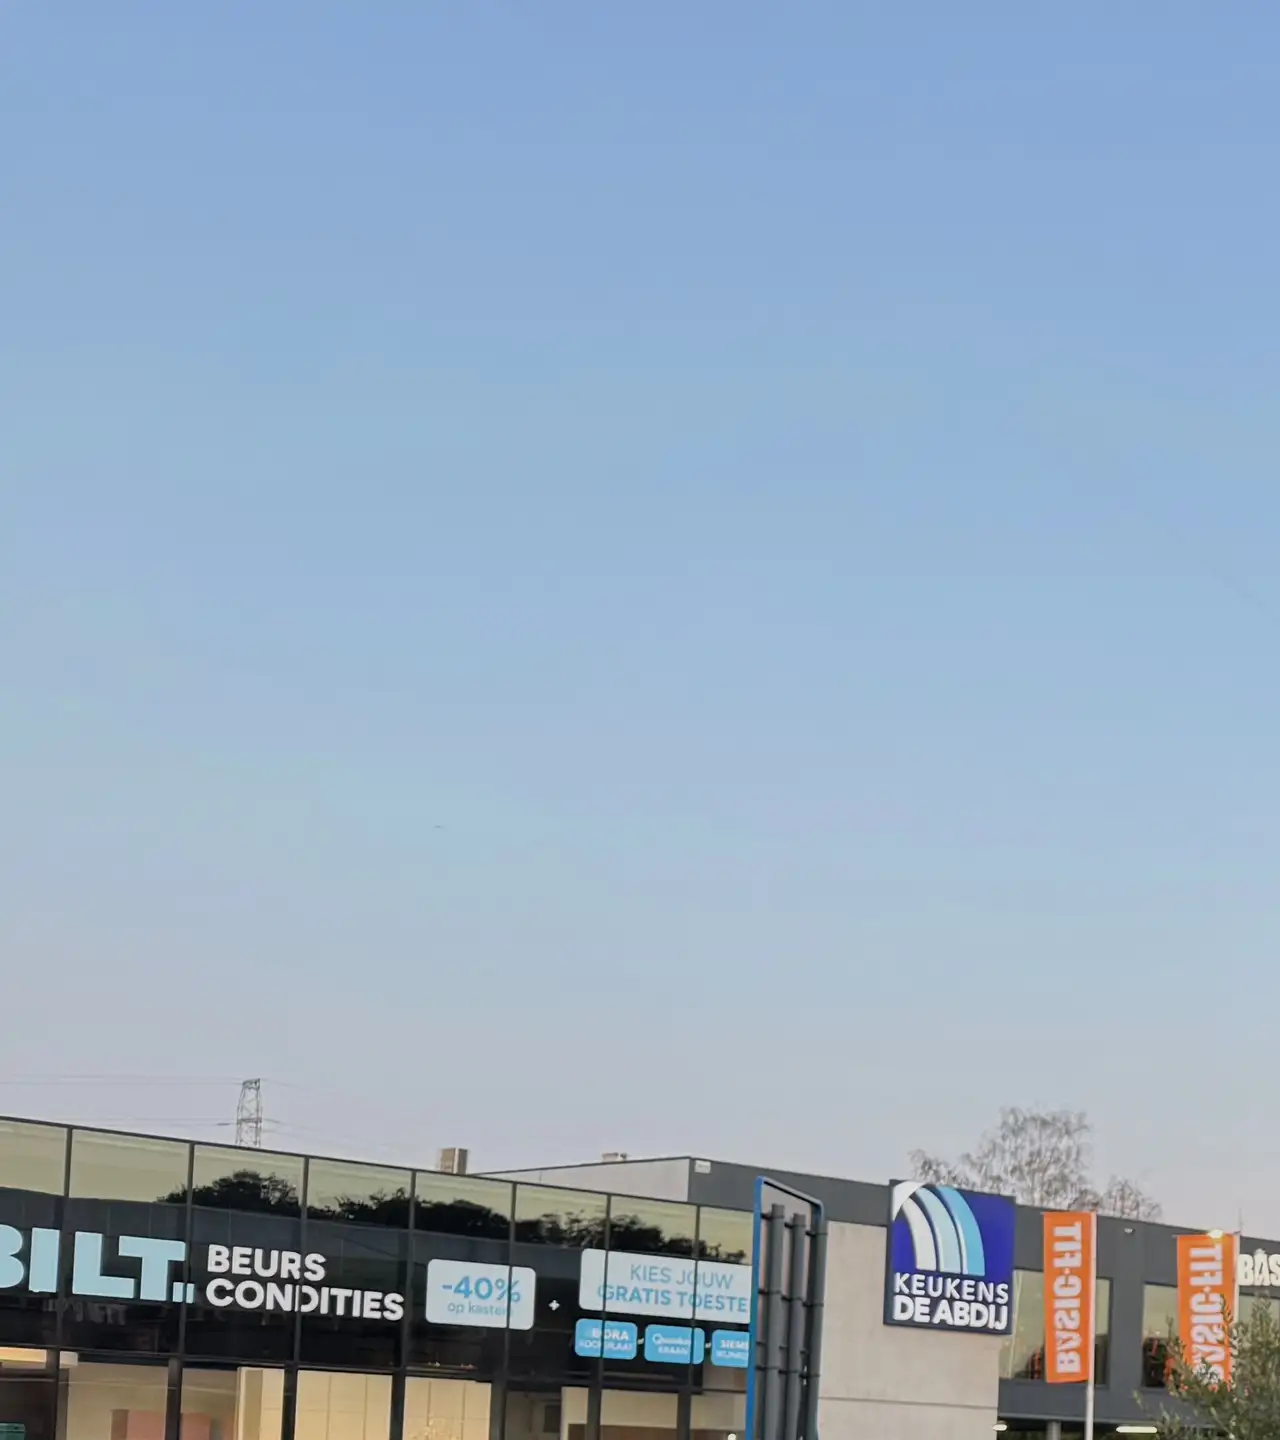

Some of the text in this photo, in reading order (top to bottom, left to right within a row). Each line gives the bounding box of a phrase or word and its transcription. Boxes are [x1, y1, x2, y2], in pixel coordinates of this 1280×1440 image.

[206, 1244, 327, 1281] BEURS
[630, 1263, 733, 1290] KIES JOUW
[205, 1278, 404, 1321] CONDITIES
[441, 1275, 521, 1303] -40%
[597, 1284, 748, 1313] GRATIS TOESTE
[894, 1272, 1009, 1304] KEUKENS
[447, 1302, 465, 1315] op
[892, 1294, 1008, 1331] DE ABDIJ
